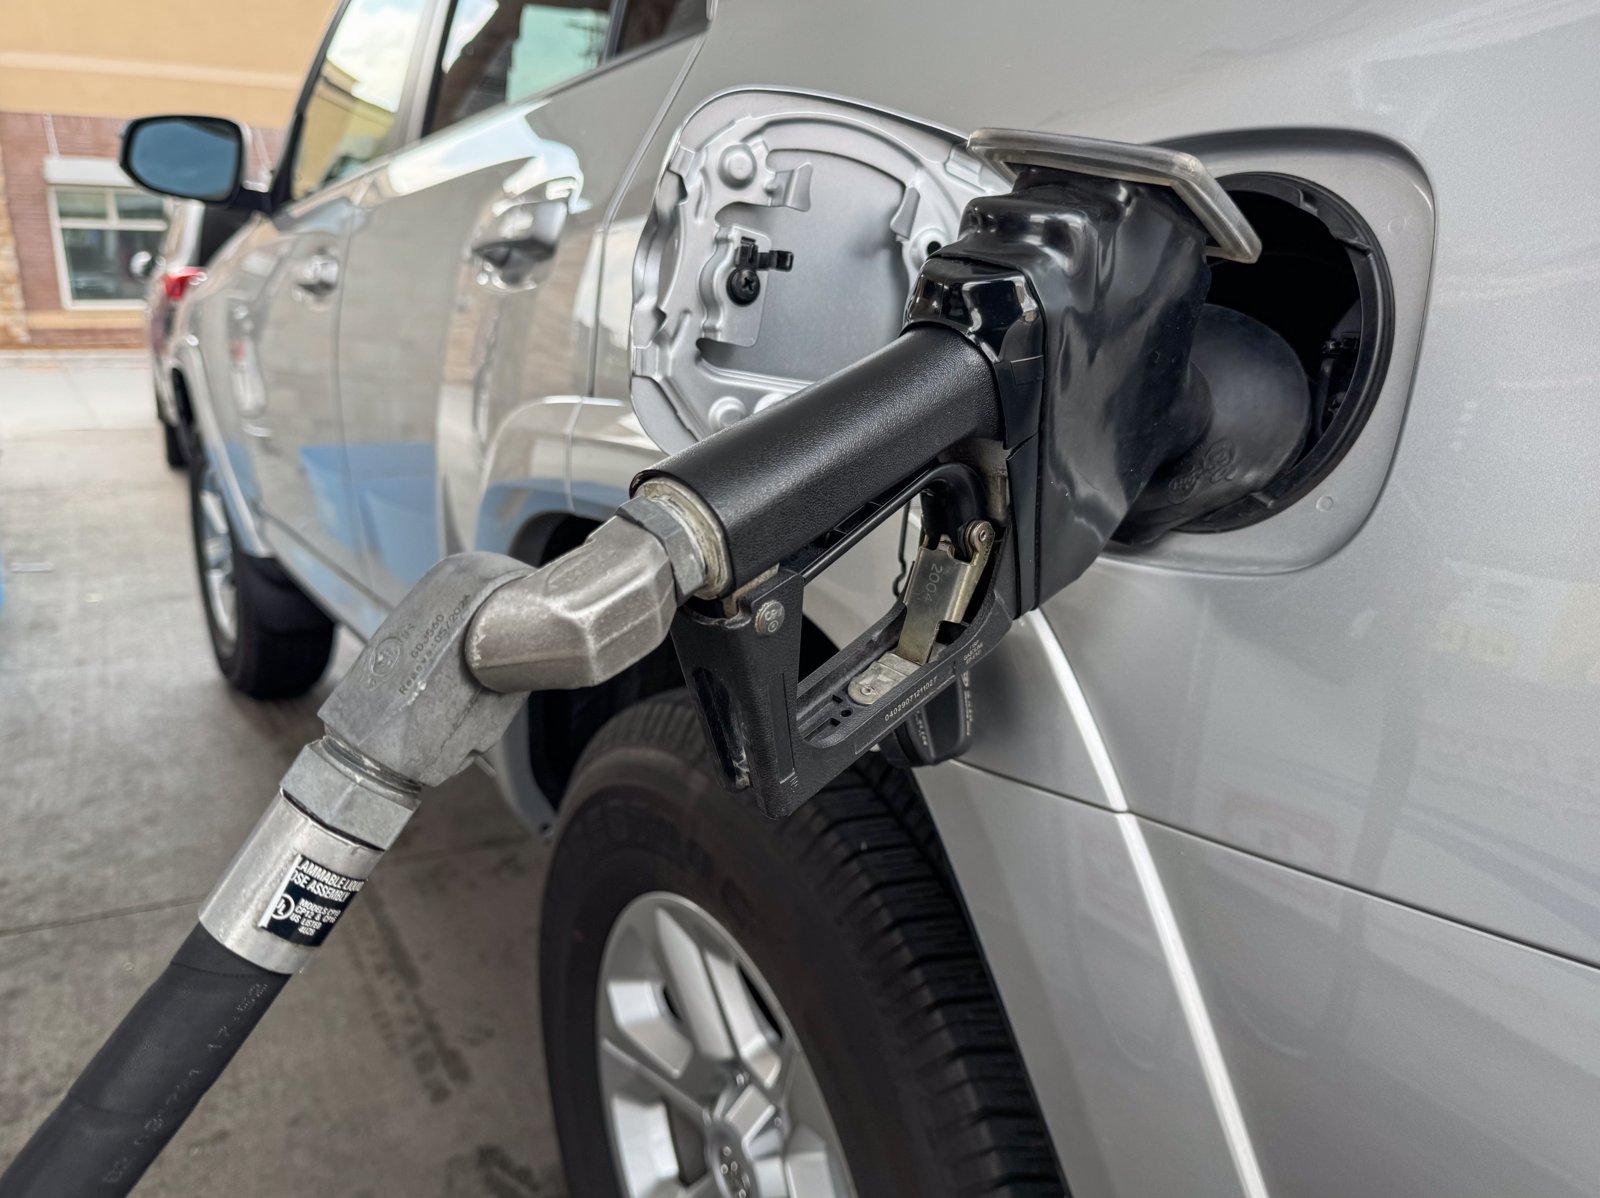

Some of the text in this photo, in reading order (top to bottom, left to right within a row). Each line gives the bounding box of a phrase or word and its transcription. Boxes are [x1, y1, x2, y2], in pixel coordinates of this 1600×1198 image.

[306, 880, 351, 902] ASSEMBLY
[300, 898, 328, 914] MODELS
[290, 912, 301, 923] US
